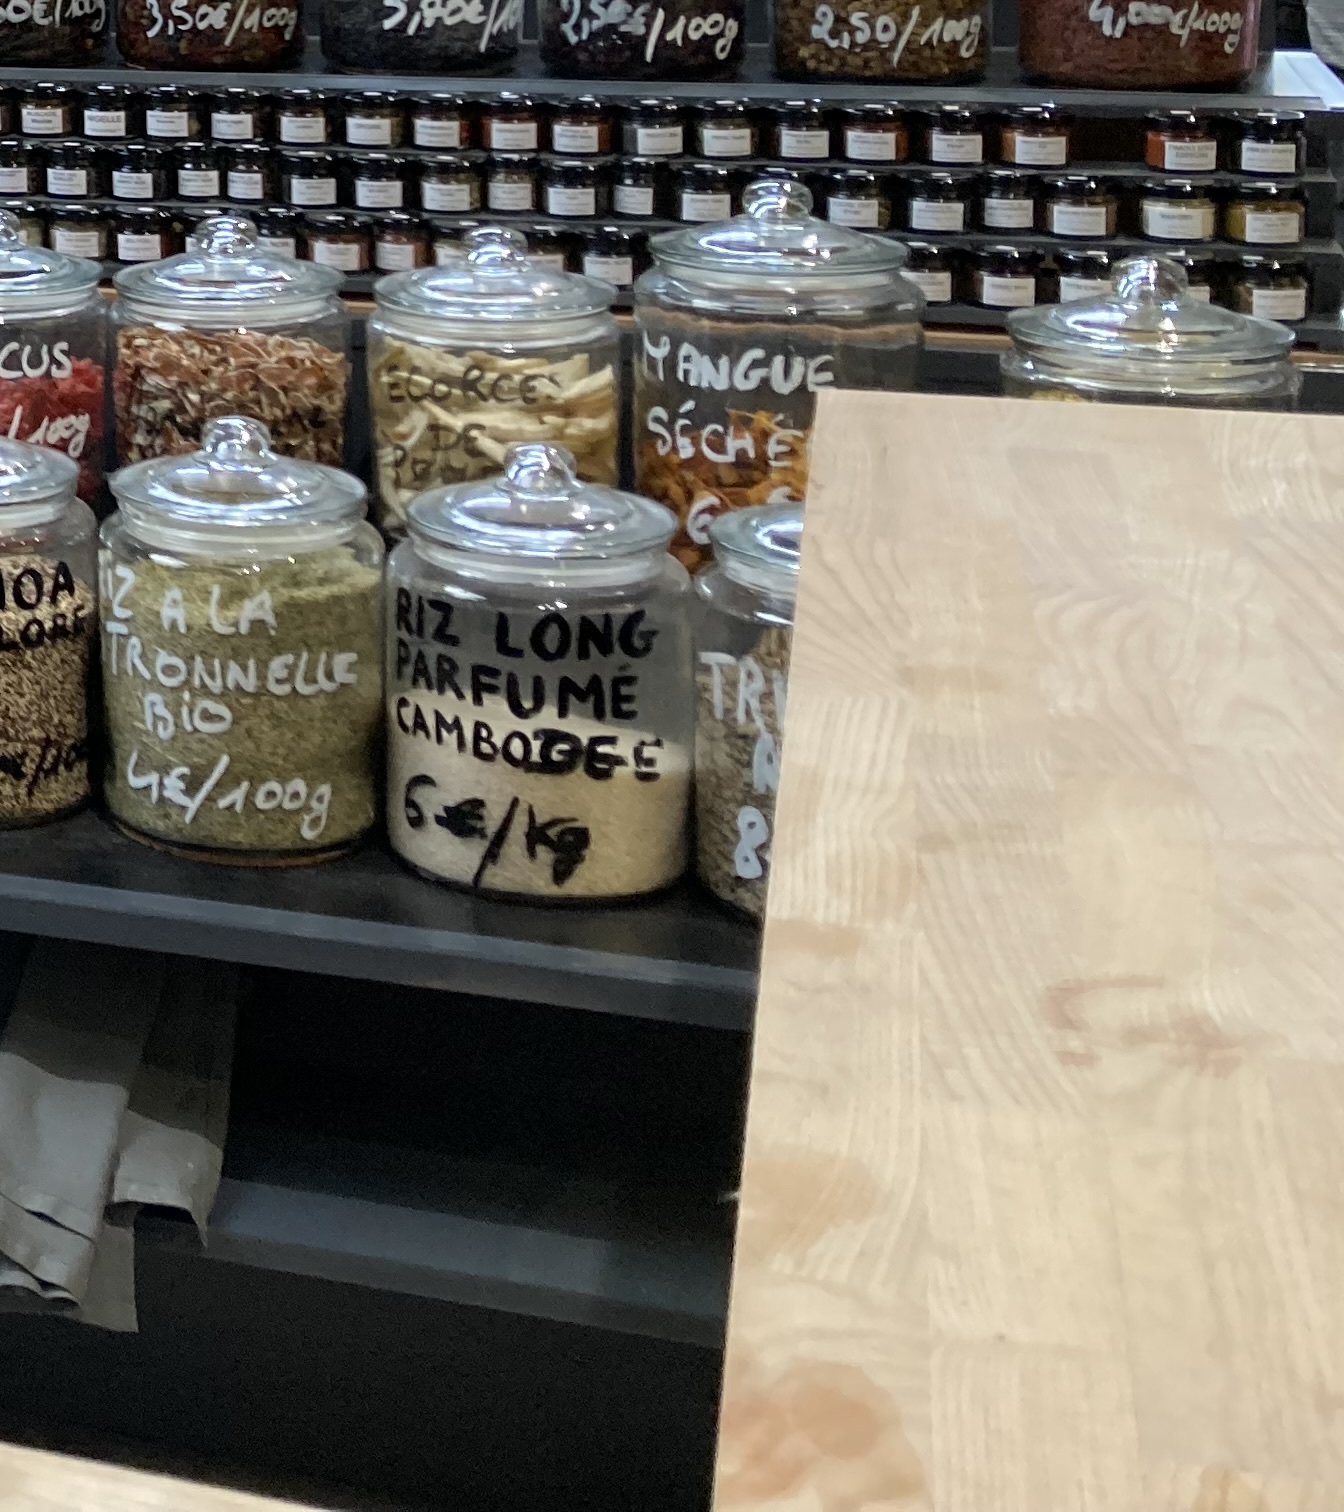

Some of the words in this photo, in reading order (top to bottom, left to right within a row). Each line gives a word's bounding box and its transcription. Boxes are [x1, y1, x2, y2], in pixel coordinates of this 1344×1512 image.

[209, 584, 278, 636] LA
[395, 587, 461, 648] RIZ
[494, 609, 660, 662] LONG
[127, 749, 332, 840] 4€/100g
